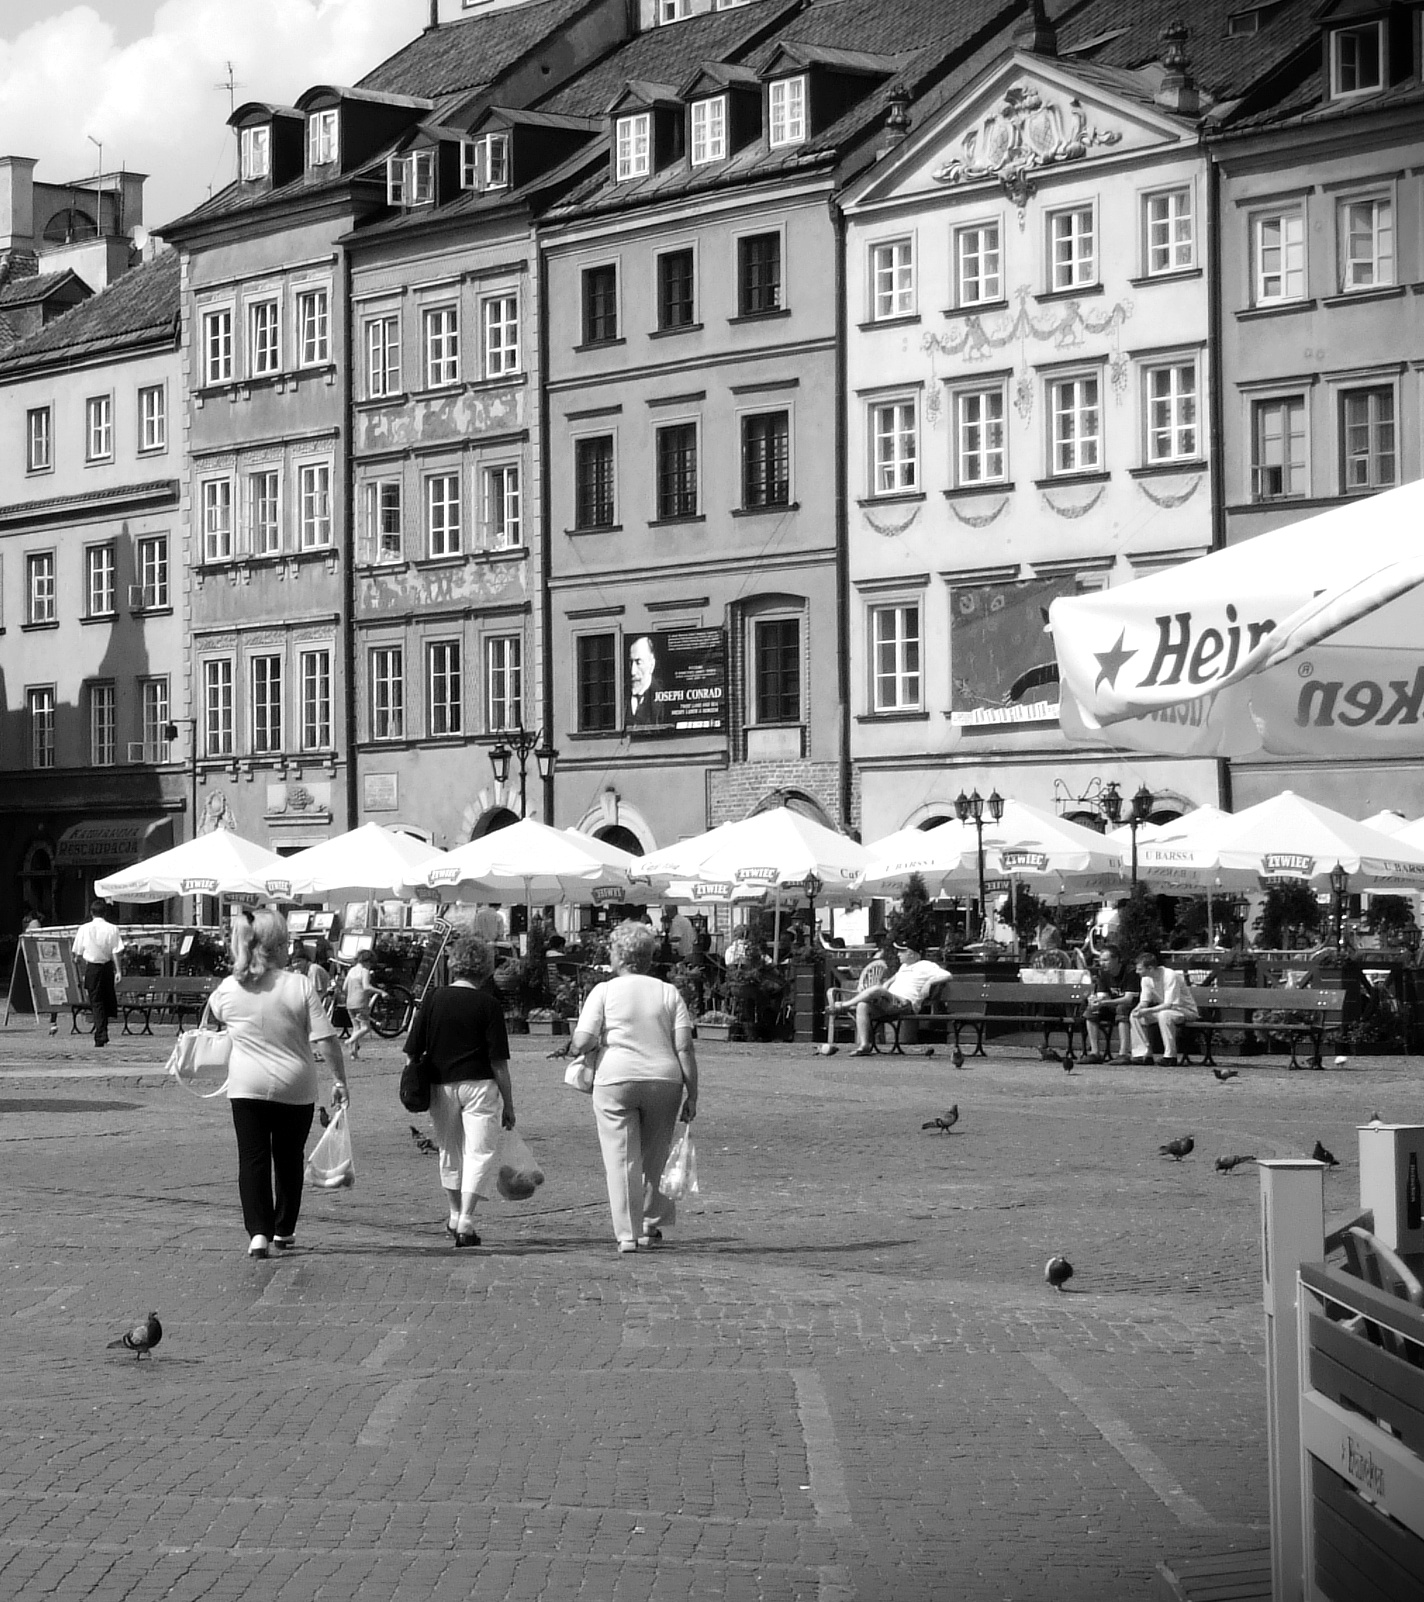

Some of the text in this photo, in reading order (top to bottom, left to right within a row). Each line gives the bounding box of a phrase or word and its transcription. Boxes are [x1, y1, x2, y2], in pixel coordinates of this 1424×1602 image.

[654, 687, 722, 702] JOSEPH CONRAD
[1394, 863, 1424, 874] BARS
